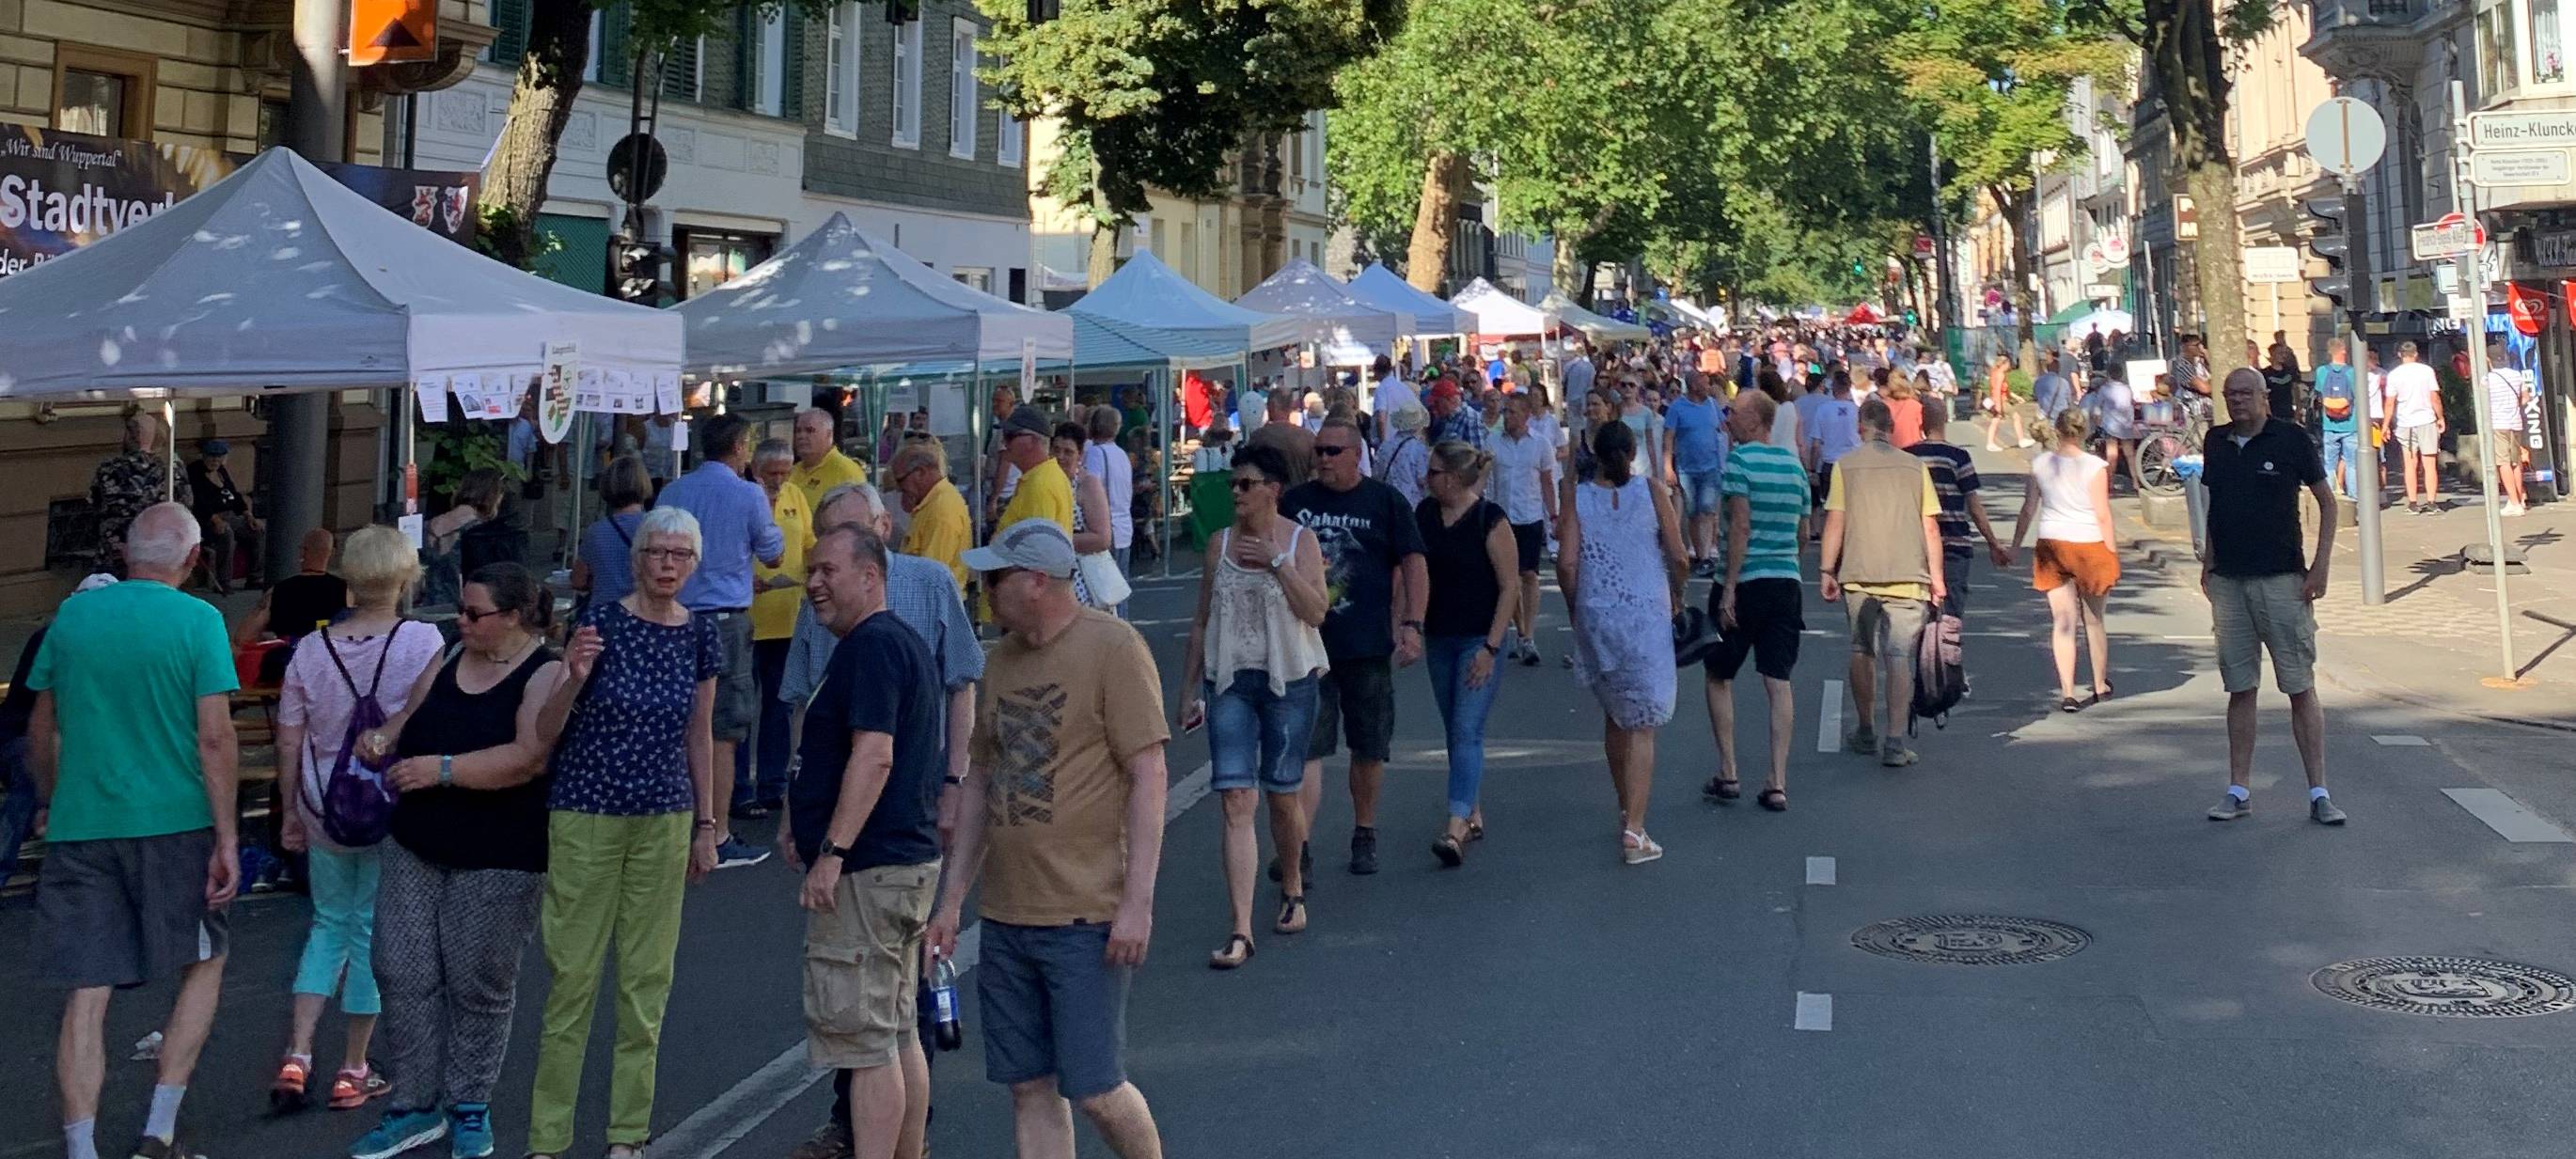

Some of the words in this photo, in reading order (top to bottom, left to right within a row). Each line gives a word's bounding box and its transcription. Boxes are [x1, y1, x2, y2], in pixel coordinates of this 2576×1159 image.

[2483, 120, 2576, 139] Heinz-Klunck
[32, 142, 57, 160] sind
[2521, 368, 2544, 449] BOXING
